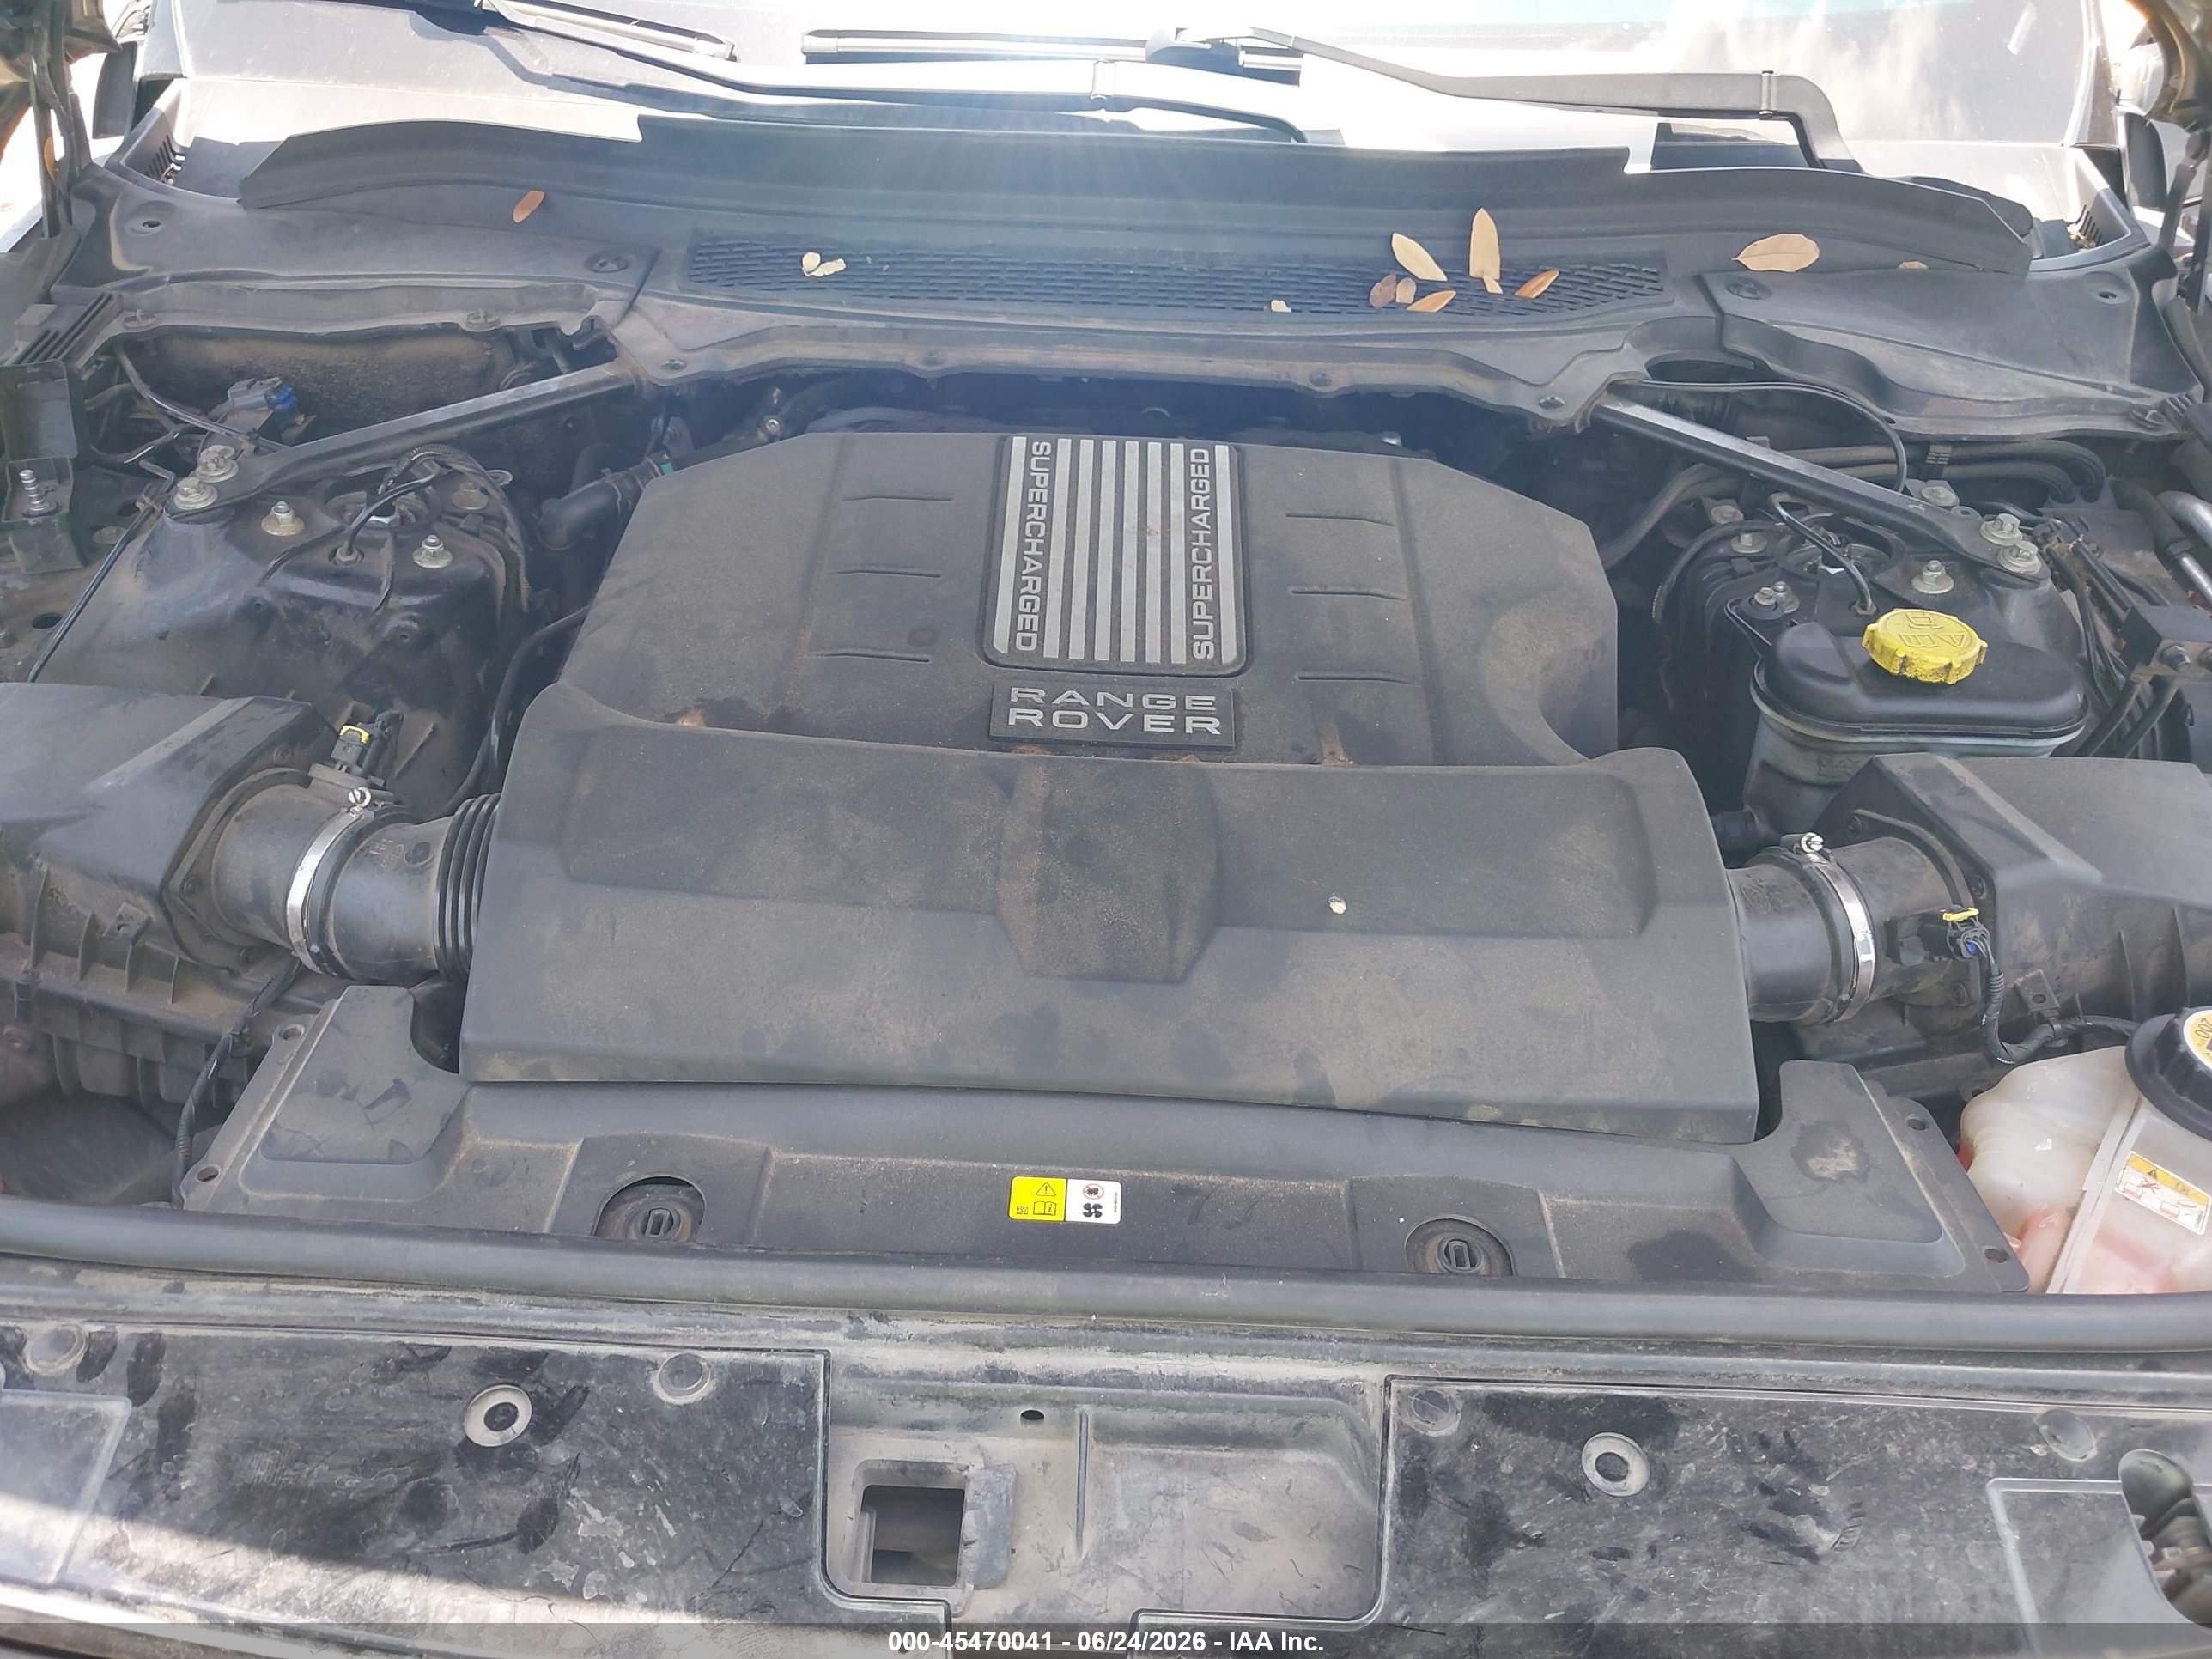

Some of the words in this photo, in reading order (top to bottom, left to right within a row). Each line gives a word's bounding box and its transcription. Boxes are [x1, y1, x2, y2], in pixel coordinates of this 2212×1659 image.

[1015, 441, 1052, 652] SUPERCHARGED
[1190, 448, 1215, 659] SUPERCHARGED
[1007, 708, 1222, 735] ROVER
[1009, 686, 1217, 711] RANGE
